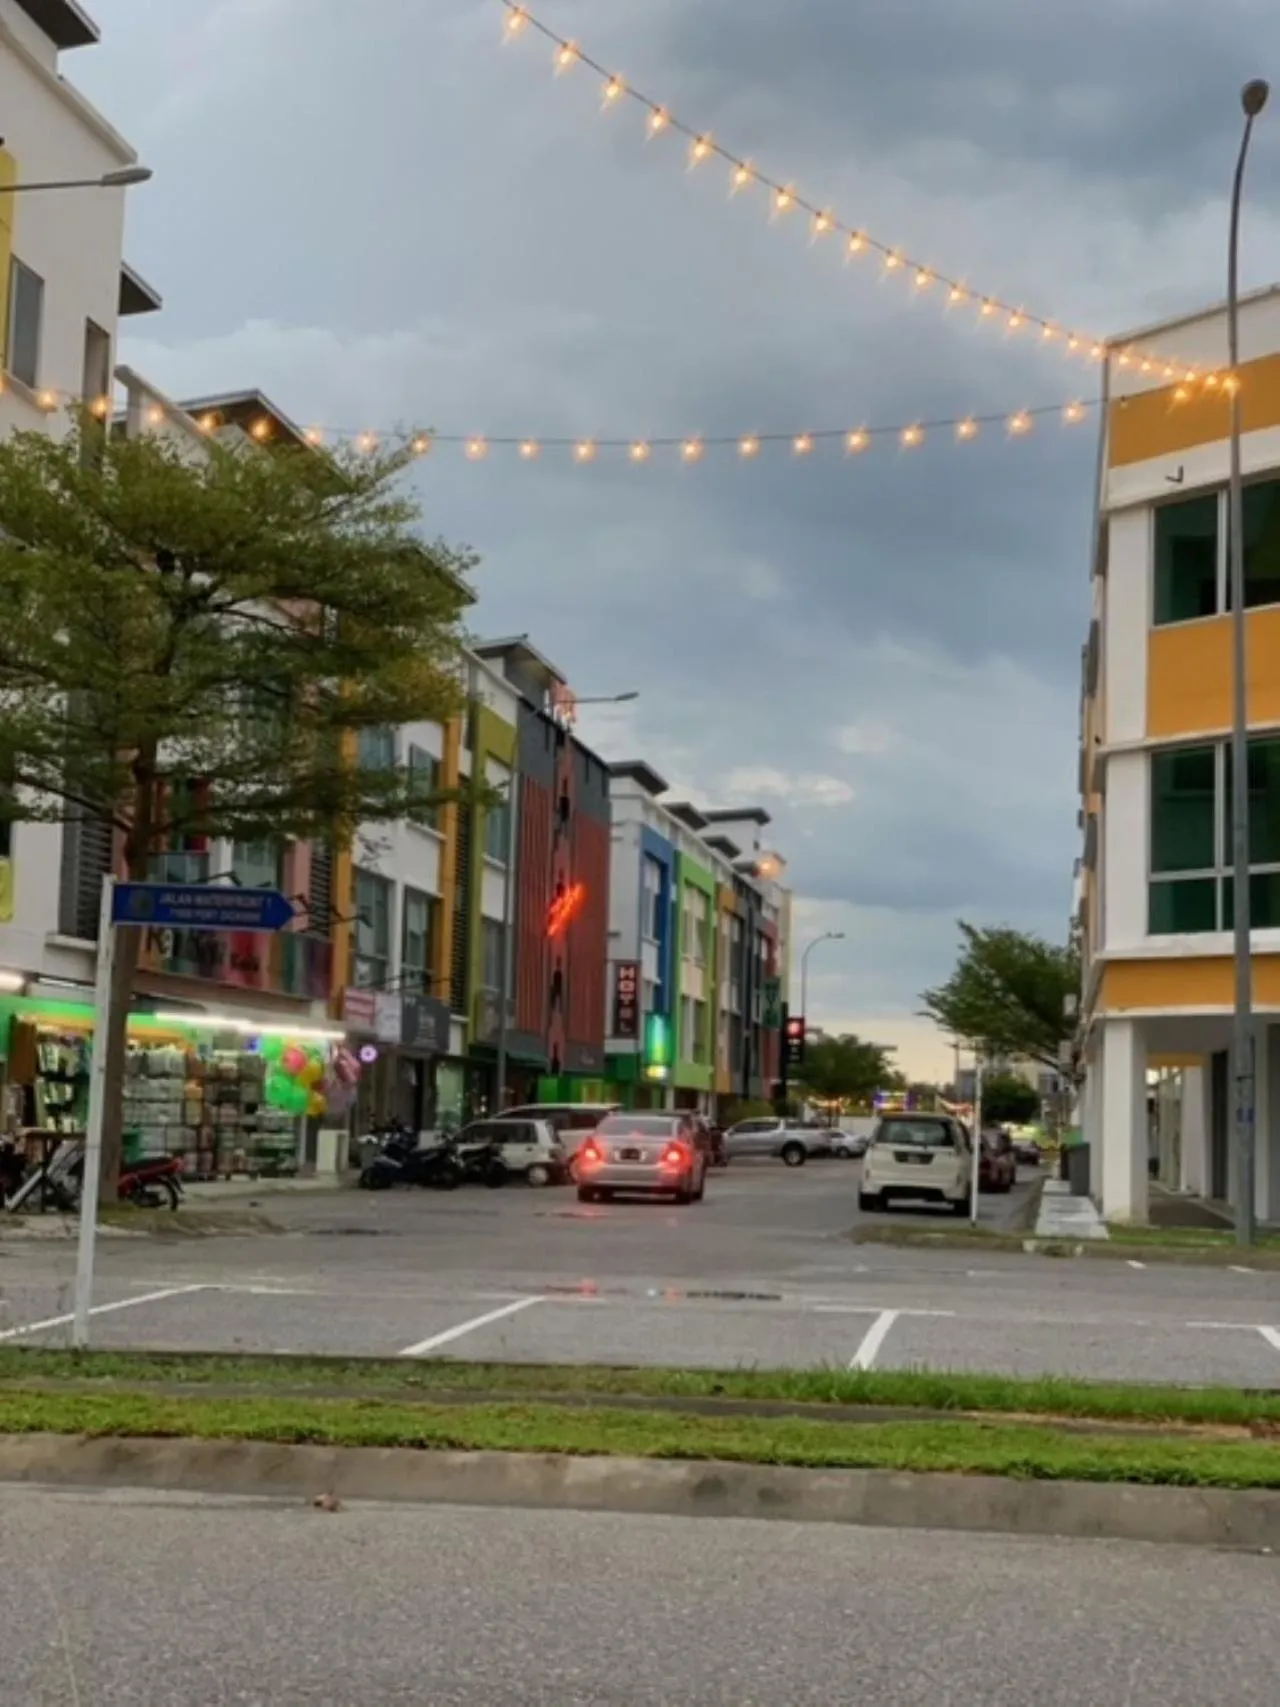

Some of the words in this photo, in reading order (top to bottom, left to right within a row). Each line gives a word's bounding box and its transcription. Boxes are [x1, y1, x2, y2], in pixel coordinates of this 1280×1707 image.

[158, 892, 191, 905] JALAN
[194, 893, 263, 908] WATERFRONT
[618, 965, 636, 1034] HOTEL
